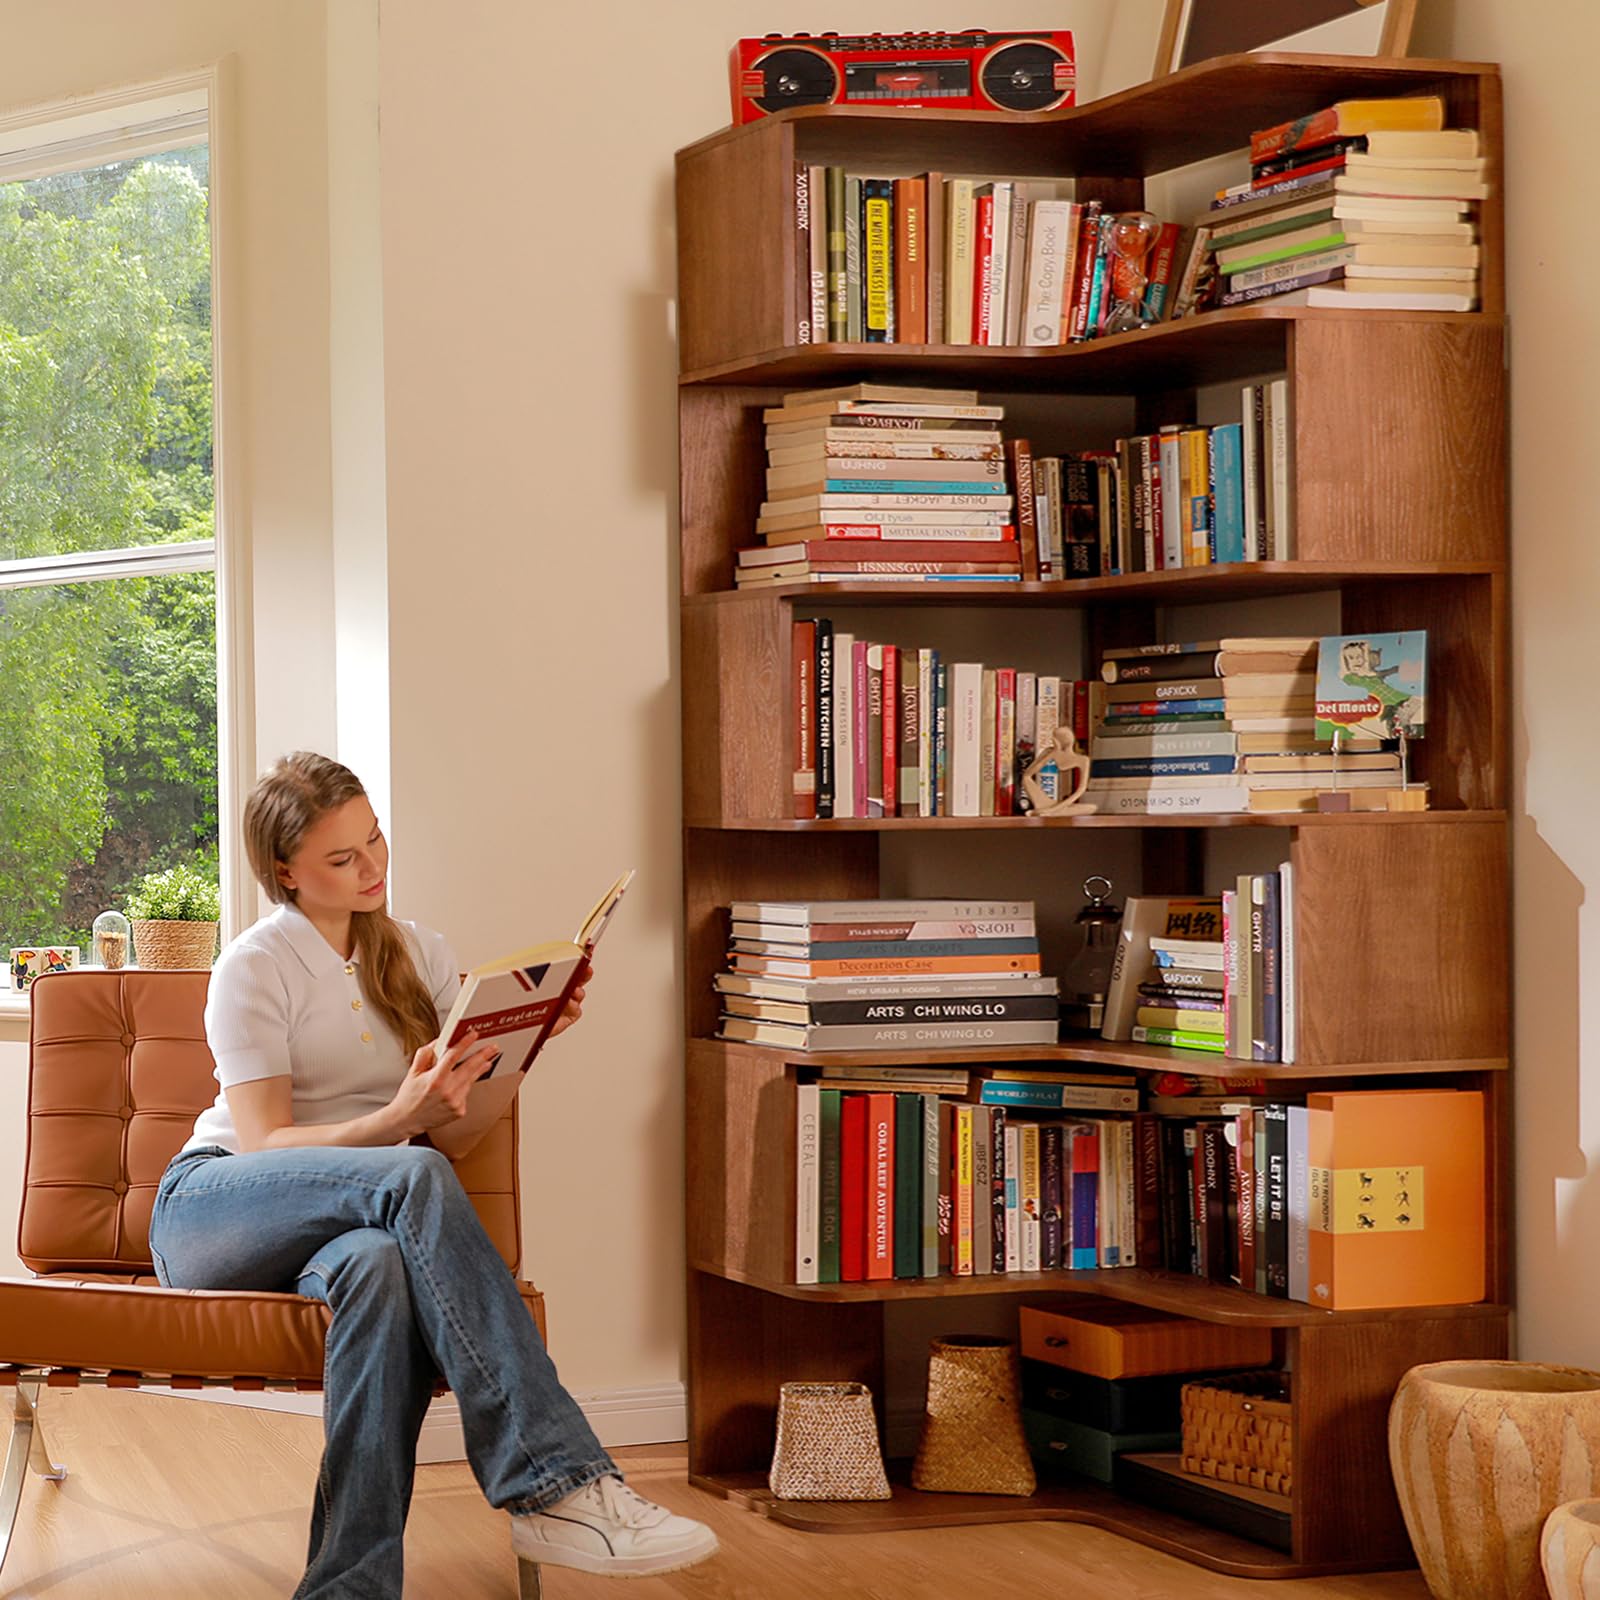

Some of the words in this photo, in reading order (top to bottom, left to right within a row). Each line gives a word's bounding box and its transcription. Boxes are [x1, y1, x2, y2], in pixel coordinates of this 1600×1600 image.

[870, 202, 884, 217] THE
[870, 220, 884, 246] MOVIE
[1041, 226, 1057, 256] Book
[870, 249, 885, 290] BUSINESS
[1038, 258, 1056, 289] Copy
[1037, 291, 1051, 312] The
[889, 529, 931, 537] MUTUAL
[932, 529, 968, 538] FUNDS
[819, 650, 829, 693] SOCIAL
[819, 697, 830, 748] KITCHEN
[958, 923, 1016, 934] HOPSCA
[1167, 912, 1217, 936] 网络
[1252, 911, 1263, 953] GHYTR
[838, 960, 903, 971] Decoration
[905, 959, 934, 969] Case
[847, 987, 868, 995] NEW
[869, 987, 899, 995] URBAN
[902, 985, 941, 994] HOUSING
[466, 1020, 493, 1032] New
[498, 1006, 549, 1025] England
[866, 1005, 905, 1018] ARTS
[914, 1005, 941, 1017] CHI
[942, 1004, 983, 1017] WING
[985, 1003, 1006, 1015] LO
[874, 1030, 907, 1041] ARTS
[915, 1030, 939, 1040] CHI
[939, 1029, 975, 1040] WING
[976, 1028, 994, 1039] LO
[803, 1113, 815, 1168] CEREAL
[877, 1122, 888, 1160] CORAL
[877, 1161, 888, 1189] REEF
[1270, 1155, 1282, 1182] LET
[1270, 1184, 1281, 1197] IT
[1270, 1200, 1282, 1220] BE
[823, 1207, 836, 1243] BOOK
[876, 1191, 888, 1259] ADVENTURE
